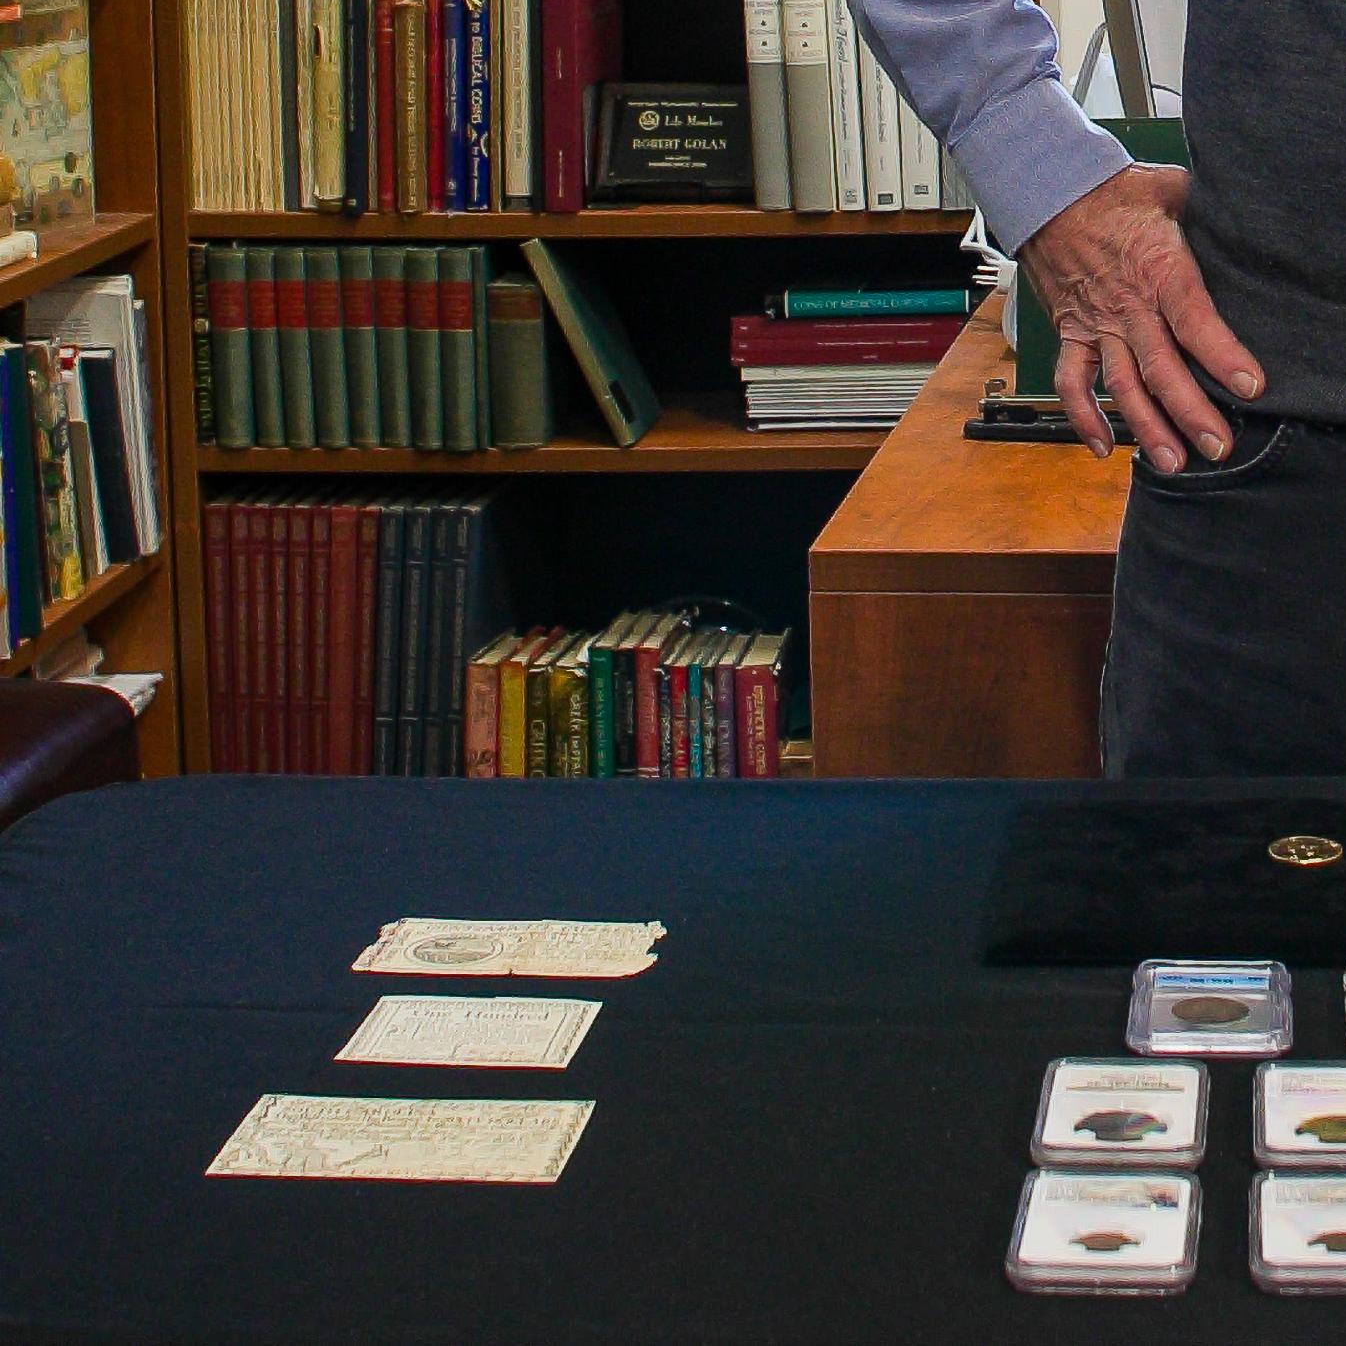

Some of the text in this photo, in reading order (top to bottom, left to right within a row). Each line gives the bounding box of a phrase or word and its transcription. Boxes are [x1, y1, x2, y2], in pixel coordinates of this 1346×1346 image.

[471, 36, 483, 86] BIBLICAL
[471, 89, 483, 124] COINS
[632, 138, 680, 149] ROBERT
